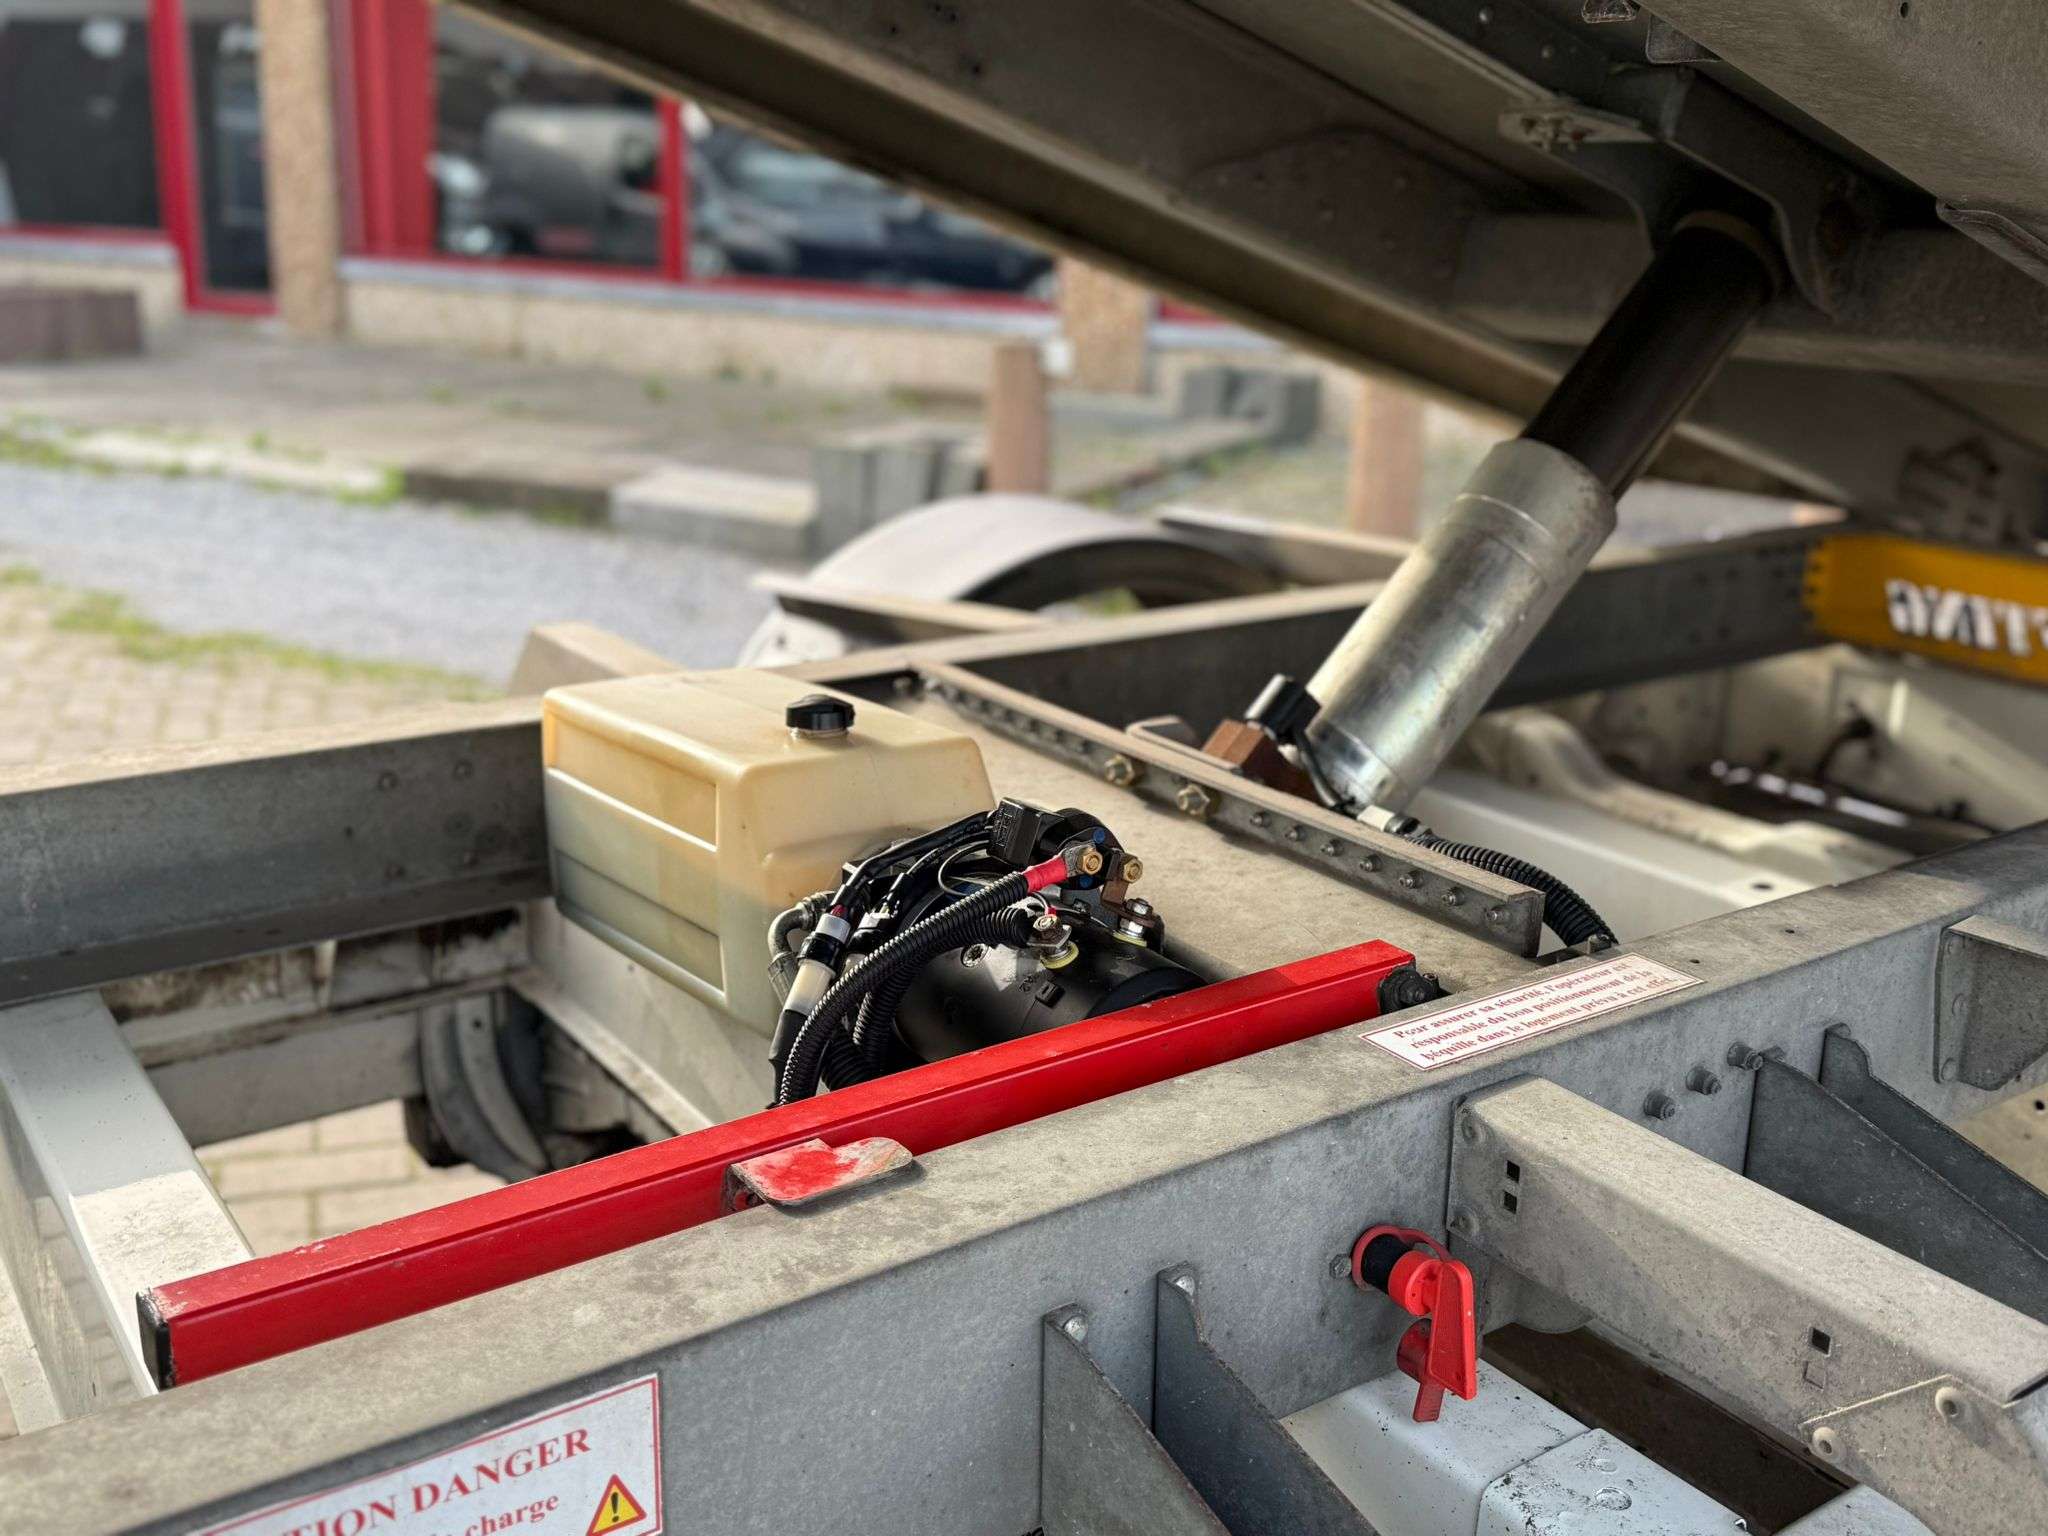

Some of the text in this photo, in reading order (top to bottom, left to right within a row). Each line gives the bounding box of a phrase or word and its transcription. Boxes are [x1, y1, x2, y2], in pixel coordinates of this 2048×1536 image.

[1410, 1020, 1489, 1049] responsable
[1487, 1014, 1506, 1025] du
[1505, 1005, 1533, 1019] bon
[1533, 978, 1624, 1012] positionnement
[1623, 974, 1641, 983] de
[1420, 1038, 1477, 1060] béquille
[1477, 1027, 1510, 1043] dans
[1521, 1004, 1581, 1026] logement
[1430, 1009, 1477, 1028] assurer
[1478, 1004, 1495, 1013] sa
[410, 1428, 592, 1514] DANGER
[465, 1494, 560, 1536] charge
